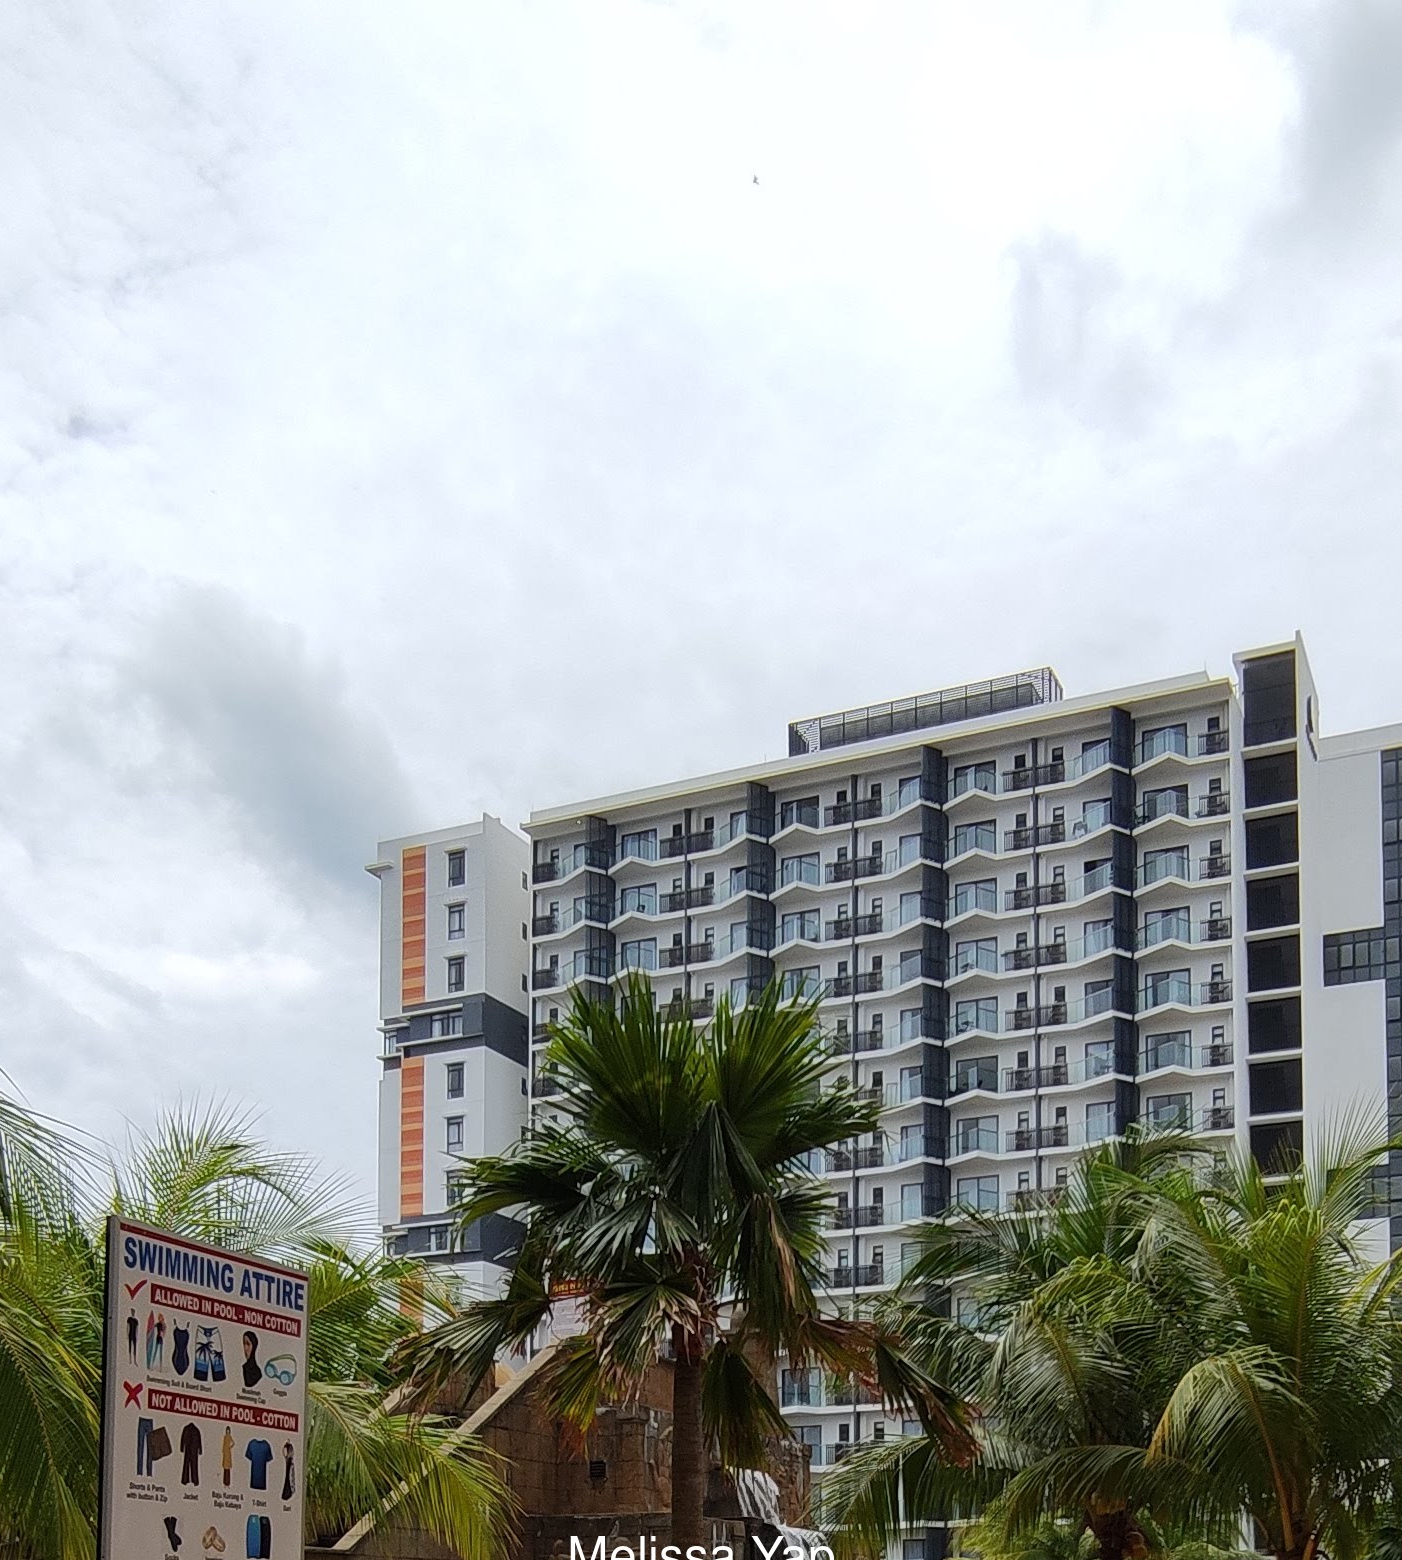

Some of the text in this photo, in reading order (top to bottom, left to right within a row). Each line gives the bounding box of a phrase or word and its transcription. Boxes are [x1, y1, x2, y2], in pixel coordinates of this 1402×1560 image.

[124, 1236, 304, 1312] SWIMMING ATTIRE
[154, 1288, 198, 1311] ALLOWED
[201, 1300, 211, 1314] IN
[213, 1303, 238, 1321] POOL
[244, 1310, 264, 1326] NON
[265, 1315, 298, 1335] COTTON
[151, 1393, 172, 1410] NOT
[173, 1397, 218, 1416] ALLOWED
[220, 1406, 230, 1419] IN
[232, 1408, 255, 1423] POOL
[262, 1411, 296, 1429] COTTON
